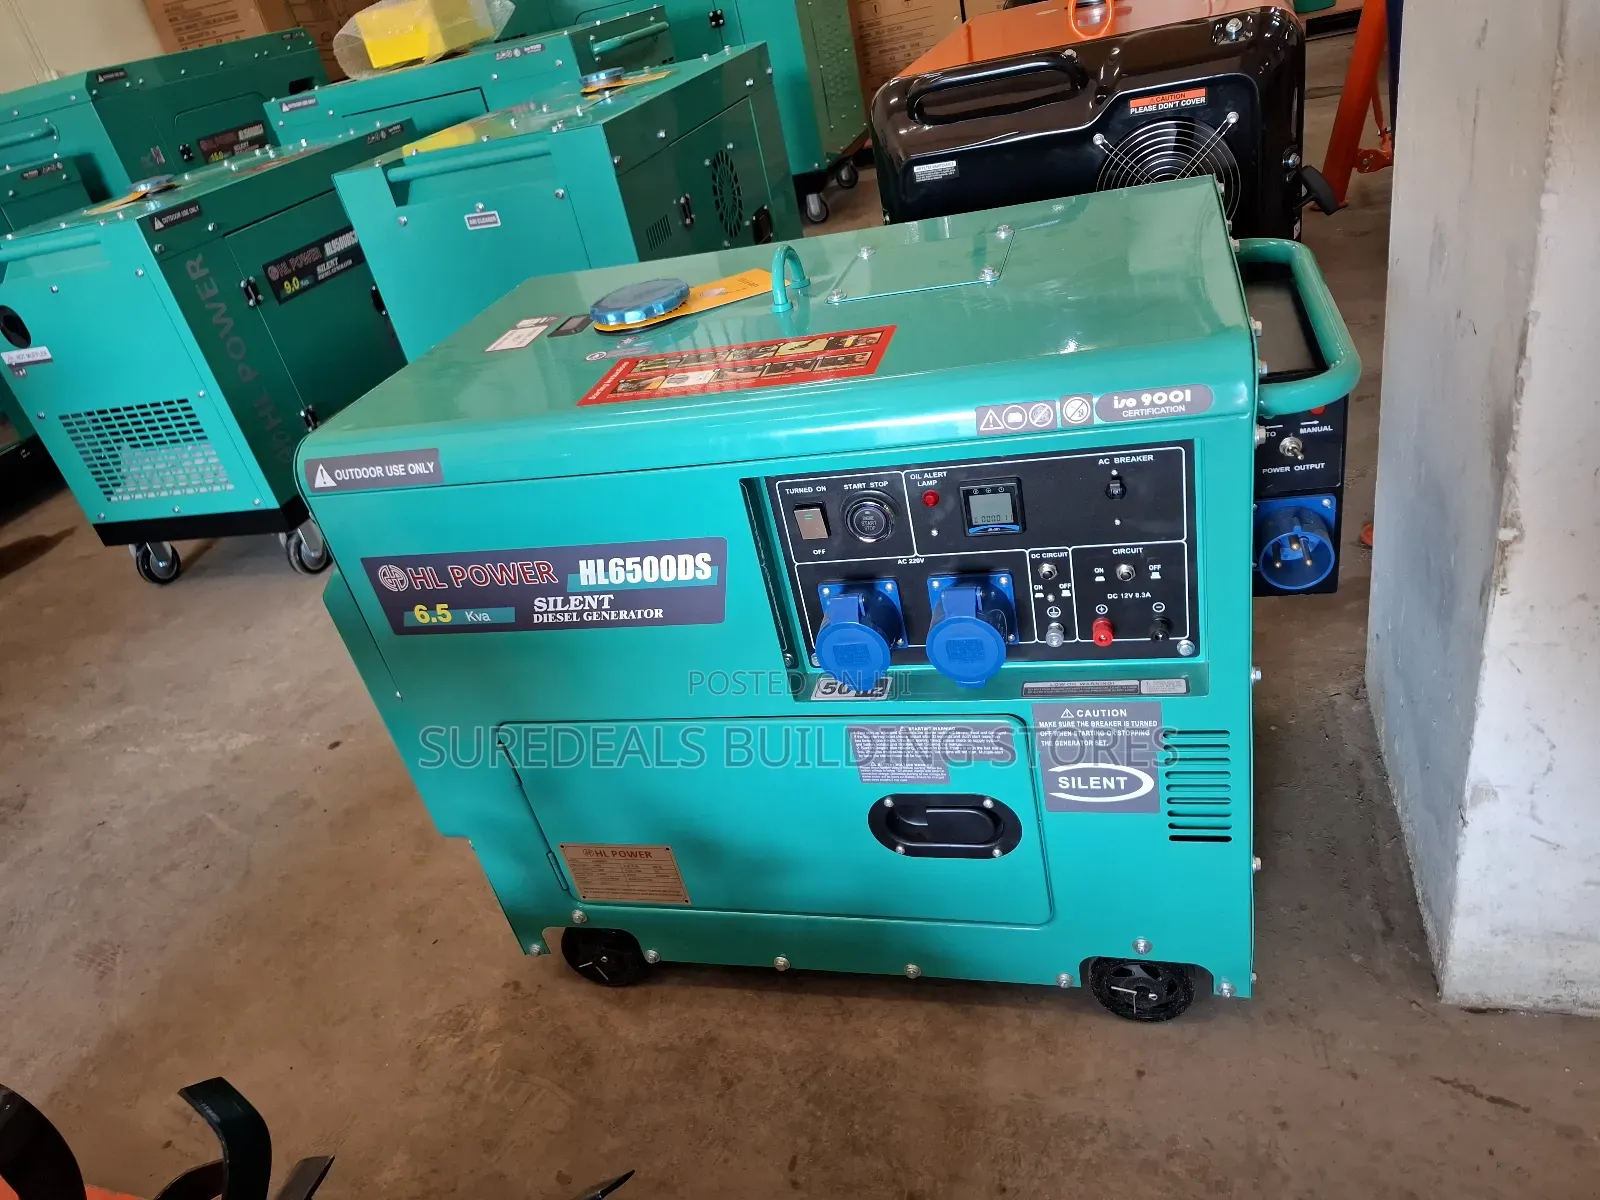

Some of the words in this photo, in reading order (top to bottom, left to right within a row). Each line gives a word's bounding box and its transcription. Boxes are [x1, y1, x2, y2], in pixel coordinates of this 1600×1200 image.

[1155, 93, 1186, 103] CAUTION
[1130, 104, 1157, 115] PLEASE
[1158, 101, 1180, 110] DON'T
[1180, 97, 1206, 107] COVER
[283, 276, 300, 294] 9.0
[186, 252, 259, 383] POWER
[1141, 389, 1191, 406] 9001
[1122, 404, 1186, 418] CERTIFICATION
[1300, 425, 1333, 434] MANUAL
[1098, 457, 1110, 465] AC
[1114, 454, 1154, 464] BREAKER
[334, 465, 384, 481] OUTDOOR
[385, 464, 407, 477] USE
[407, 461, 435, 475] ONLY
[923, 471, 947, 479] ALERT
[1262, 466, 1291, 475] POWER
[1294, 462, 1326, 472] OUTPUT
[843, 482, 867, 490] START
[869, 480, 889, 488] STOP
[917, 479, 938, 487] LAMP
[785, 486, 814, 495] TURNED
[816, 485, 827, 493] ON
[813, 548, 826, 556] OFF
[1112, 547, 1144, 555] CIRCUIT
[406, 566, 448, 591] HL
[448, 560, 559, 589] POWER
[578, 552, 712, 586] HL6500DS
[533, 594, 615, 612] SILENT
[413, 603, 452, 624] 6.5
[464, 610, 491, 623] Kva
[532, 611, 581, 624] DIESEL
[582, 608, 664, 623] GENERATOR
[1076, 708, 1128, 718] CAUTION
[1058, 776, 1128, 790] SILENT
[594, 850, 610, 858] HL
[611, 850, 653, 859] POWER
